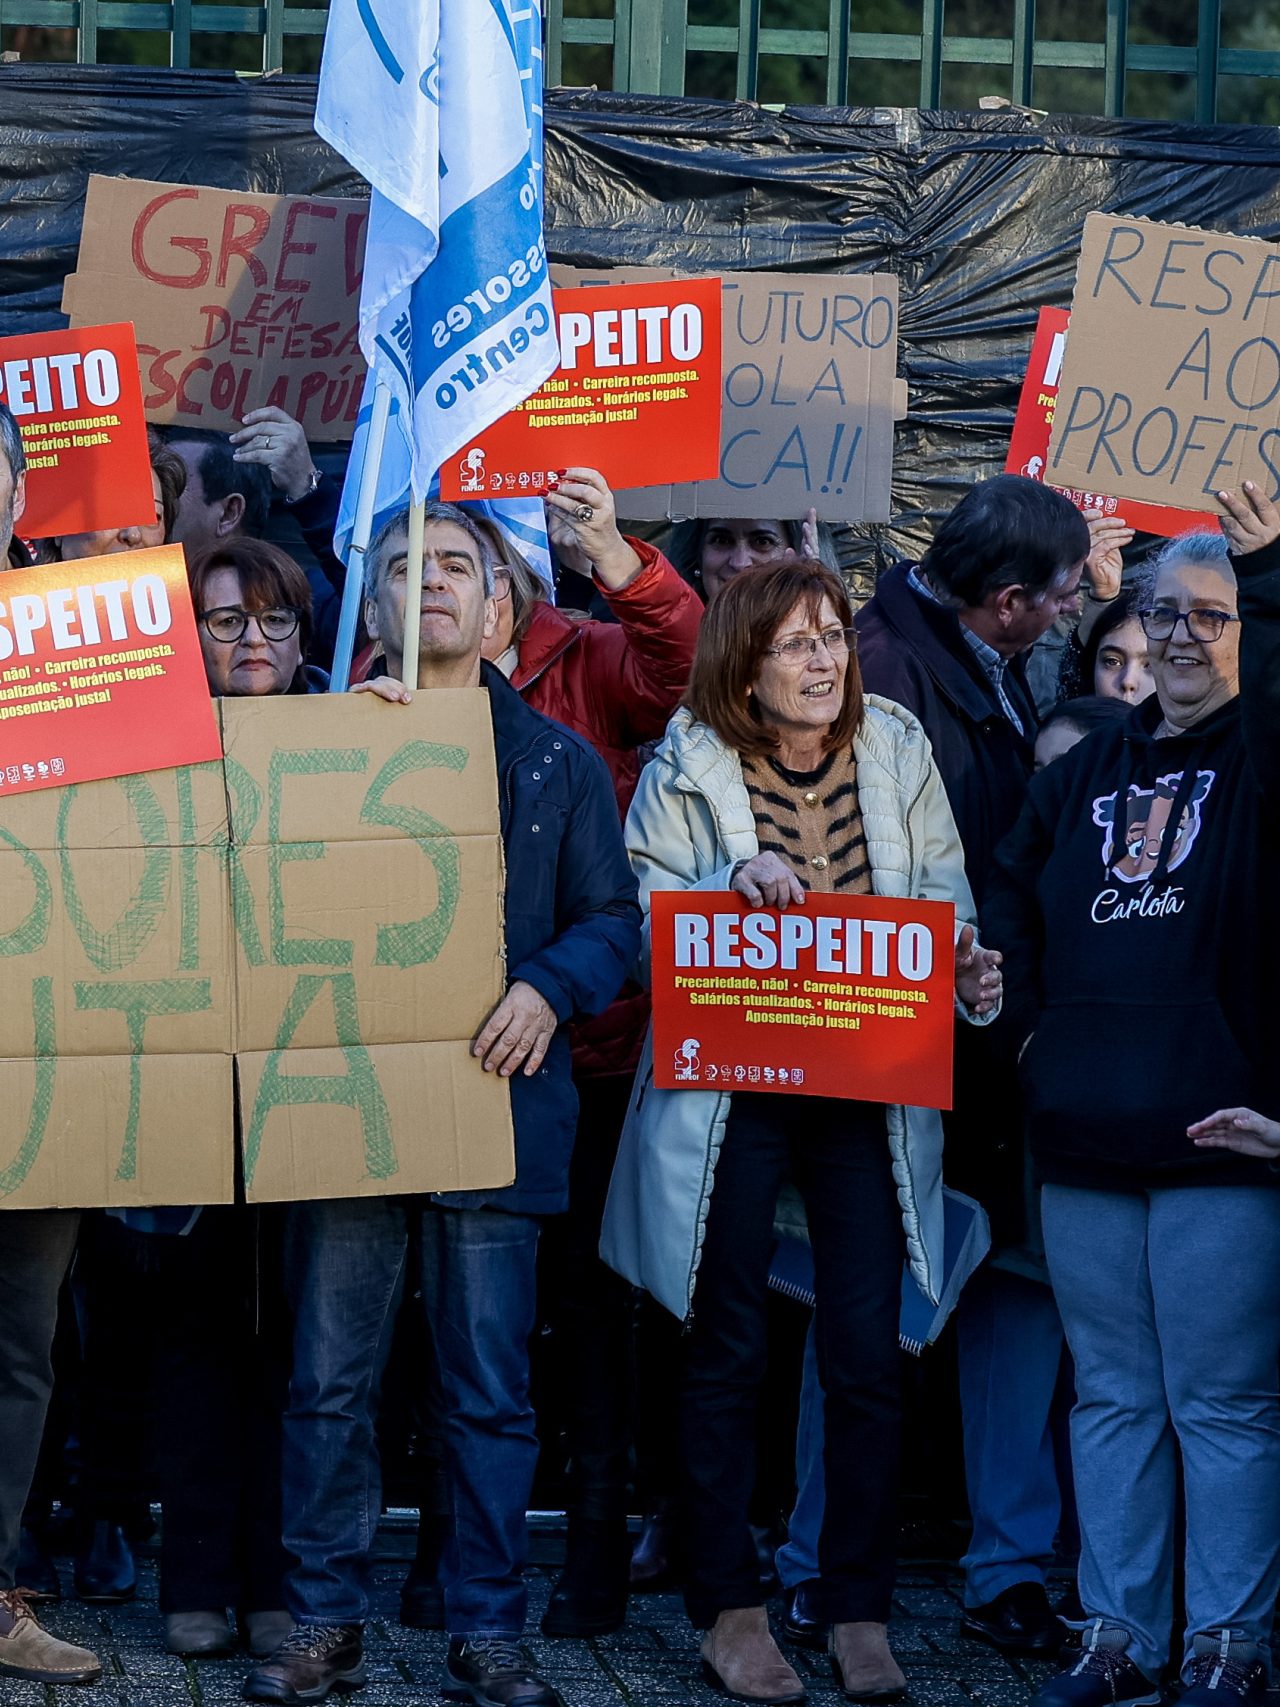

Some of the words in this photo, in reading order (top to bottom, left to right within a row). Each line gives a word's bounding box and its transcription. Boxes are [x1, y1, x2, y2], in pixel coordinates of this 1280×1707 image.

[131, 188, 368, 297] GREV
[1092, 226, 1280, 321] RESP
[245, 293, 304, 323] EM
[722, 283, 893, 349] UTURO
[559, 303, 702, 370] PEITO
[543, 378, 569, 393] não!
[582, 374, 630, 390] Carreira
[631, 371, 700, 387] recomposta.
[724, 354, 847, 408] OLA
[525, 394, 595, 412] atualizados.
[602, 390, 651, 405] Horários
[652, 387, 690, 403] legais.
[48, 415, 122, 433] recomposta.
[528, 409, 604, 429] Aposentação
[604, 406, 638, 423] justa!
[71, 431, 112, 448] legais.
[1052, 386, 1280, 502] PROFES
[24, 453, 59, 471] justa!
[2, 664, 31, 682] não!
[44, 656, 97, 675] Carreira
[97, 645, 176, 667] recomposta.
[68, 670, 124, 689] Horários
[123, 663, 167, 681] legais.
[74, 688, 111, 708] justa!
[1090, 882, 1186, 924] Carlota
[674, 912, 934, 982] RESPEITO
[674, 975, 760, 991] Precariedade,
[761, 976, 789, 991] não!
[803, 979, 853, 996] Carreira
[855, 983, 930, 1004] recomposta.
[689, 991, 741, 1006] Salários
[742, 993, 815, 1009] atualizados.
[823, 997, 875, 1015] Horários
[877, 1000, 918, 1019] legais.
[745, 1009, 824, 1029] Aposentação
[825, 1013, 861, 1030] justa!
